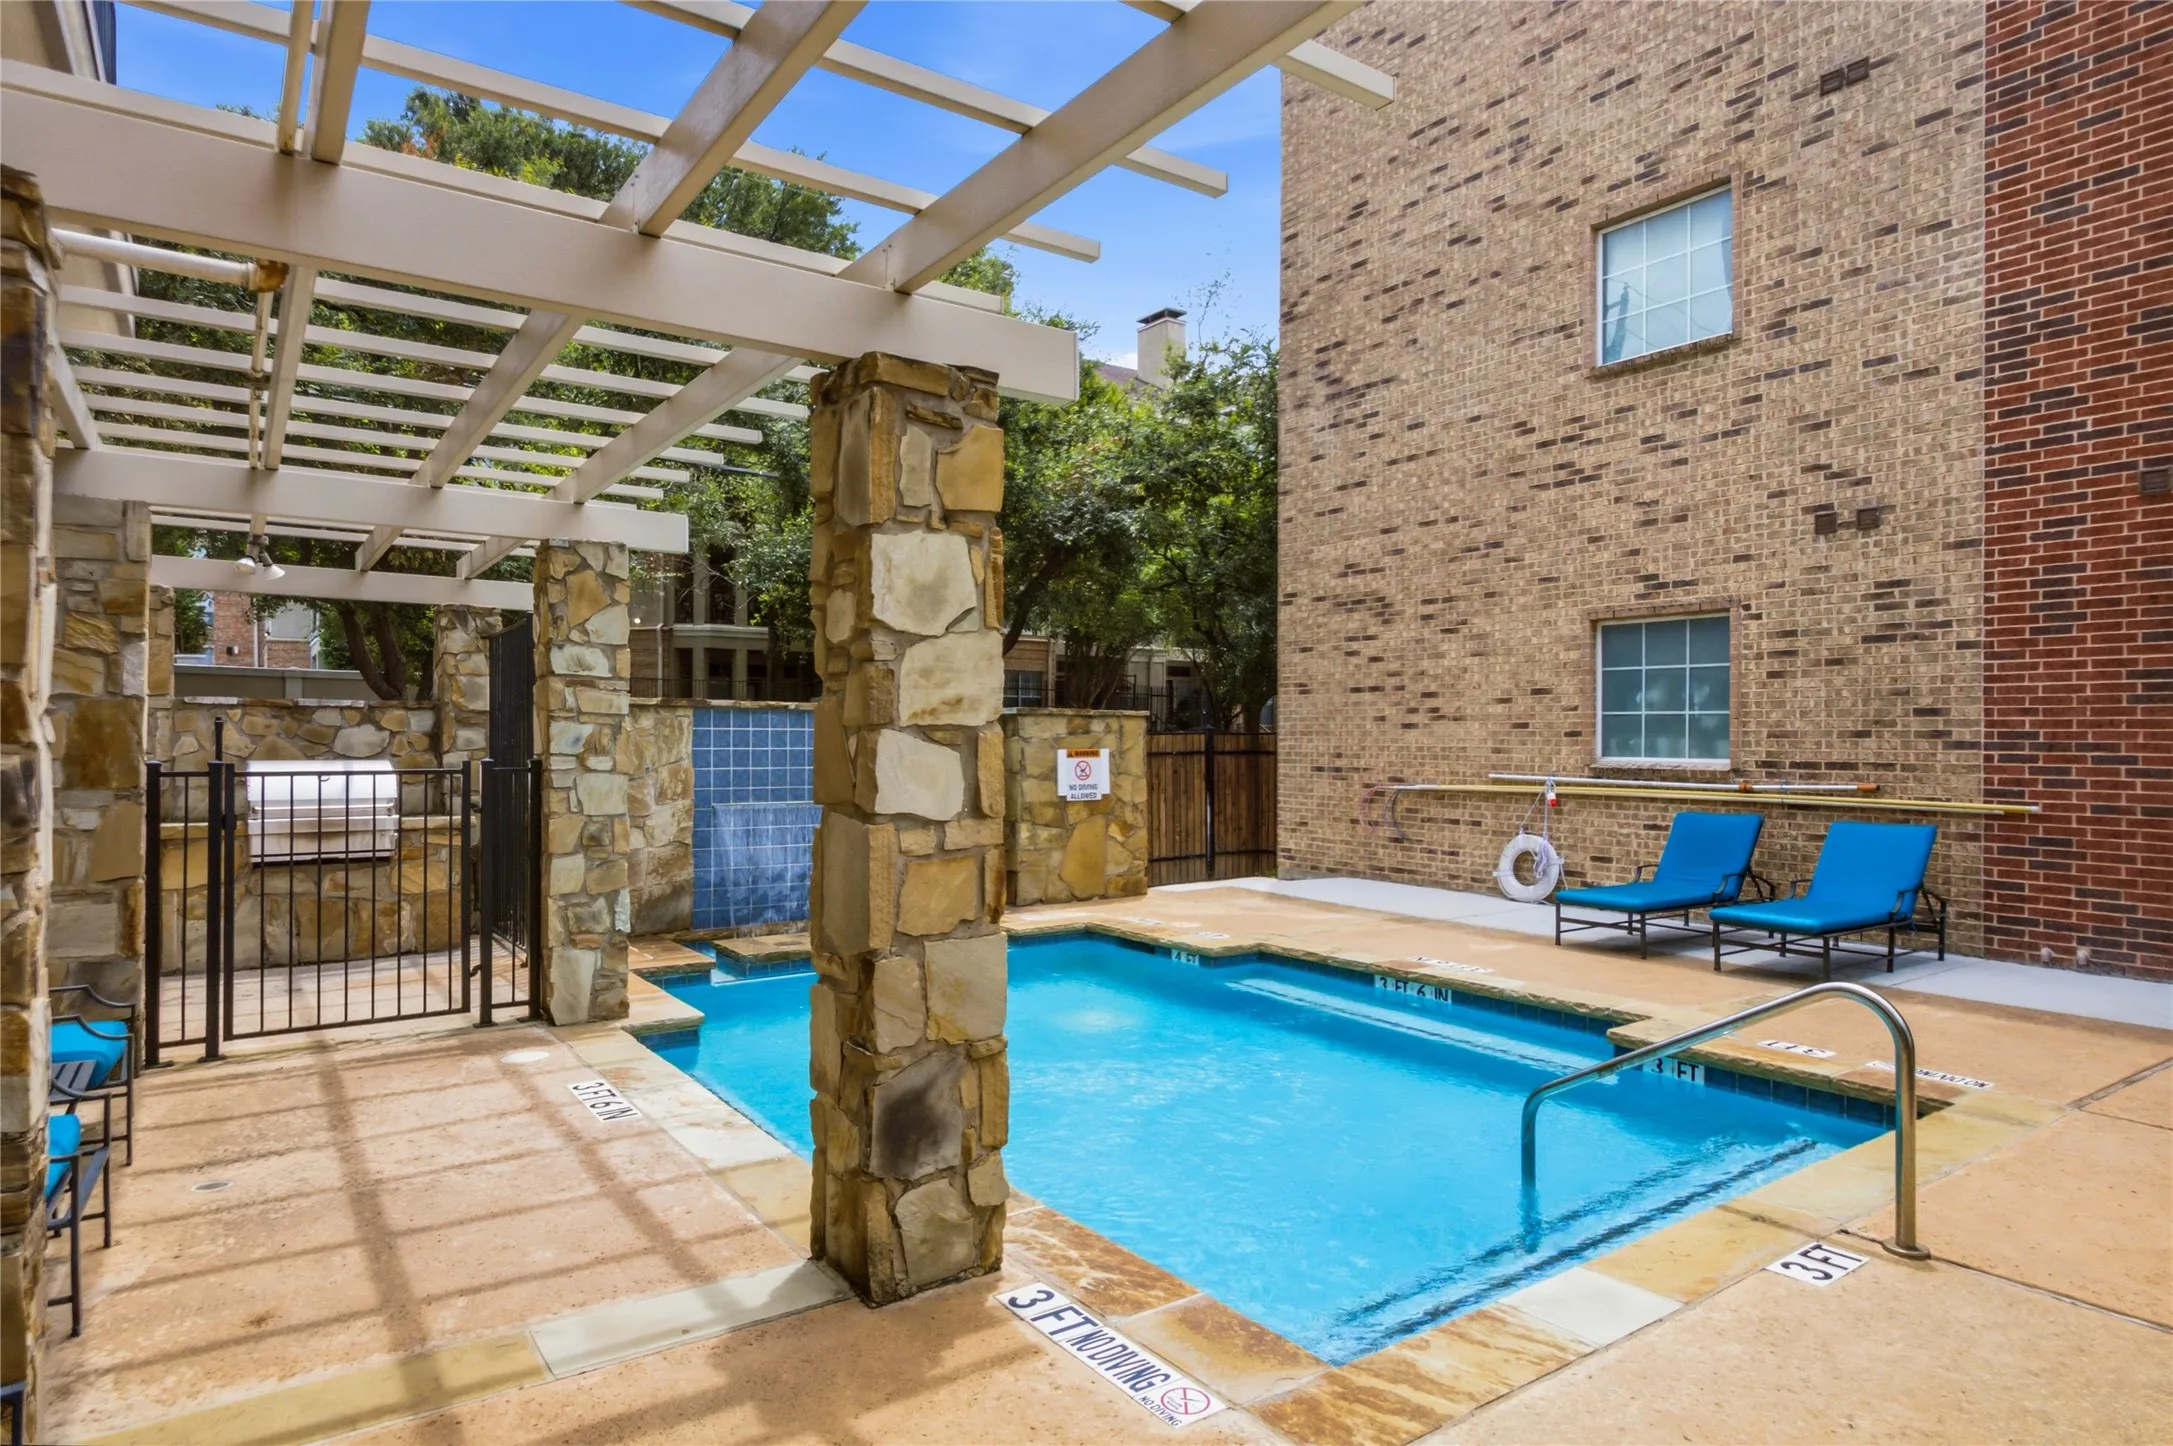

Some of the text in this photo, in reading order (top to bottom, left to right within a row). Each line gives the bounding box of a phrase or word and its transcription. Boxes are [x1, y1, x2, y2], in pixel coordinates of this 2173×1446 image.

[1070, 792, 1097, 800] ALLOWED
[1078, 783, 1098, 791] DIVING
[1394, 979, 1408, 993] FT
[1434, 986, 1449, 1002] IN
[1650, 1057, 1700, 1082] 3 FT
[572, 1082, 638, 1121] 3 FT 6 IN
[1780, 1243, 1863, 1281] 3 FT
[1007, 1289, 1172, 1393] 3 FT NO DIVING
[1139, 1395, 1182, 1427] NO DIVING
